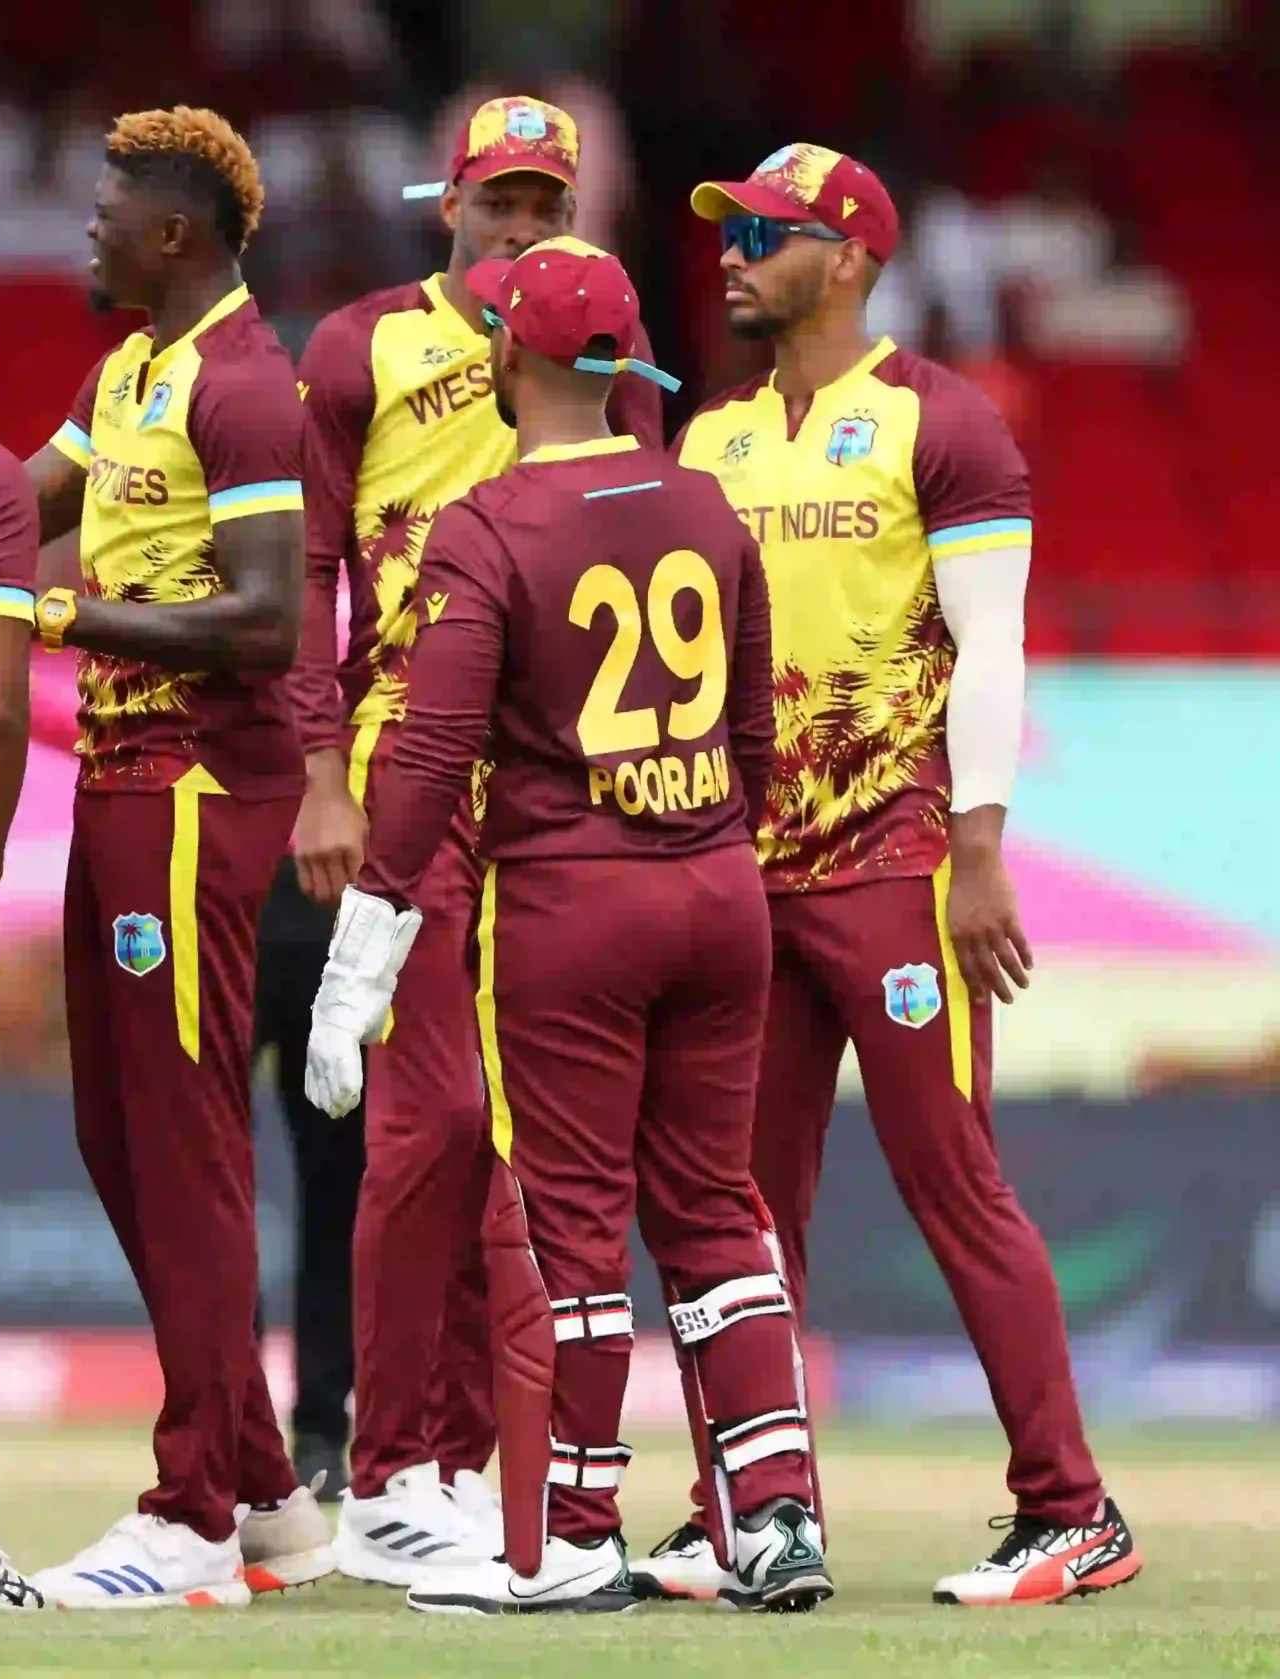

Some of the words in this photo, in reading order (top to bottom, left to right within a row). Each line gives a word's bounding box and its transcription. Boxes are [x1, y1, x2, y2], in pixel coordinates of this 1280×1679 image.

[404, 357, 493, 425] WES
[781, 500, 879, 541] INDIES
[568, 549, 727, 756] 29
[589, 746, 730, 816] POORAN
